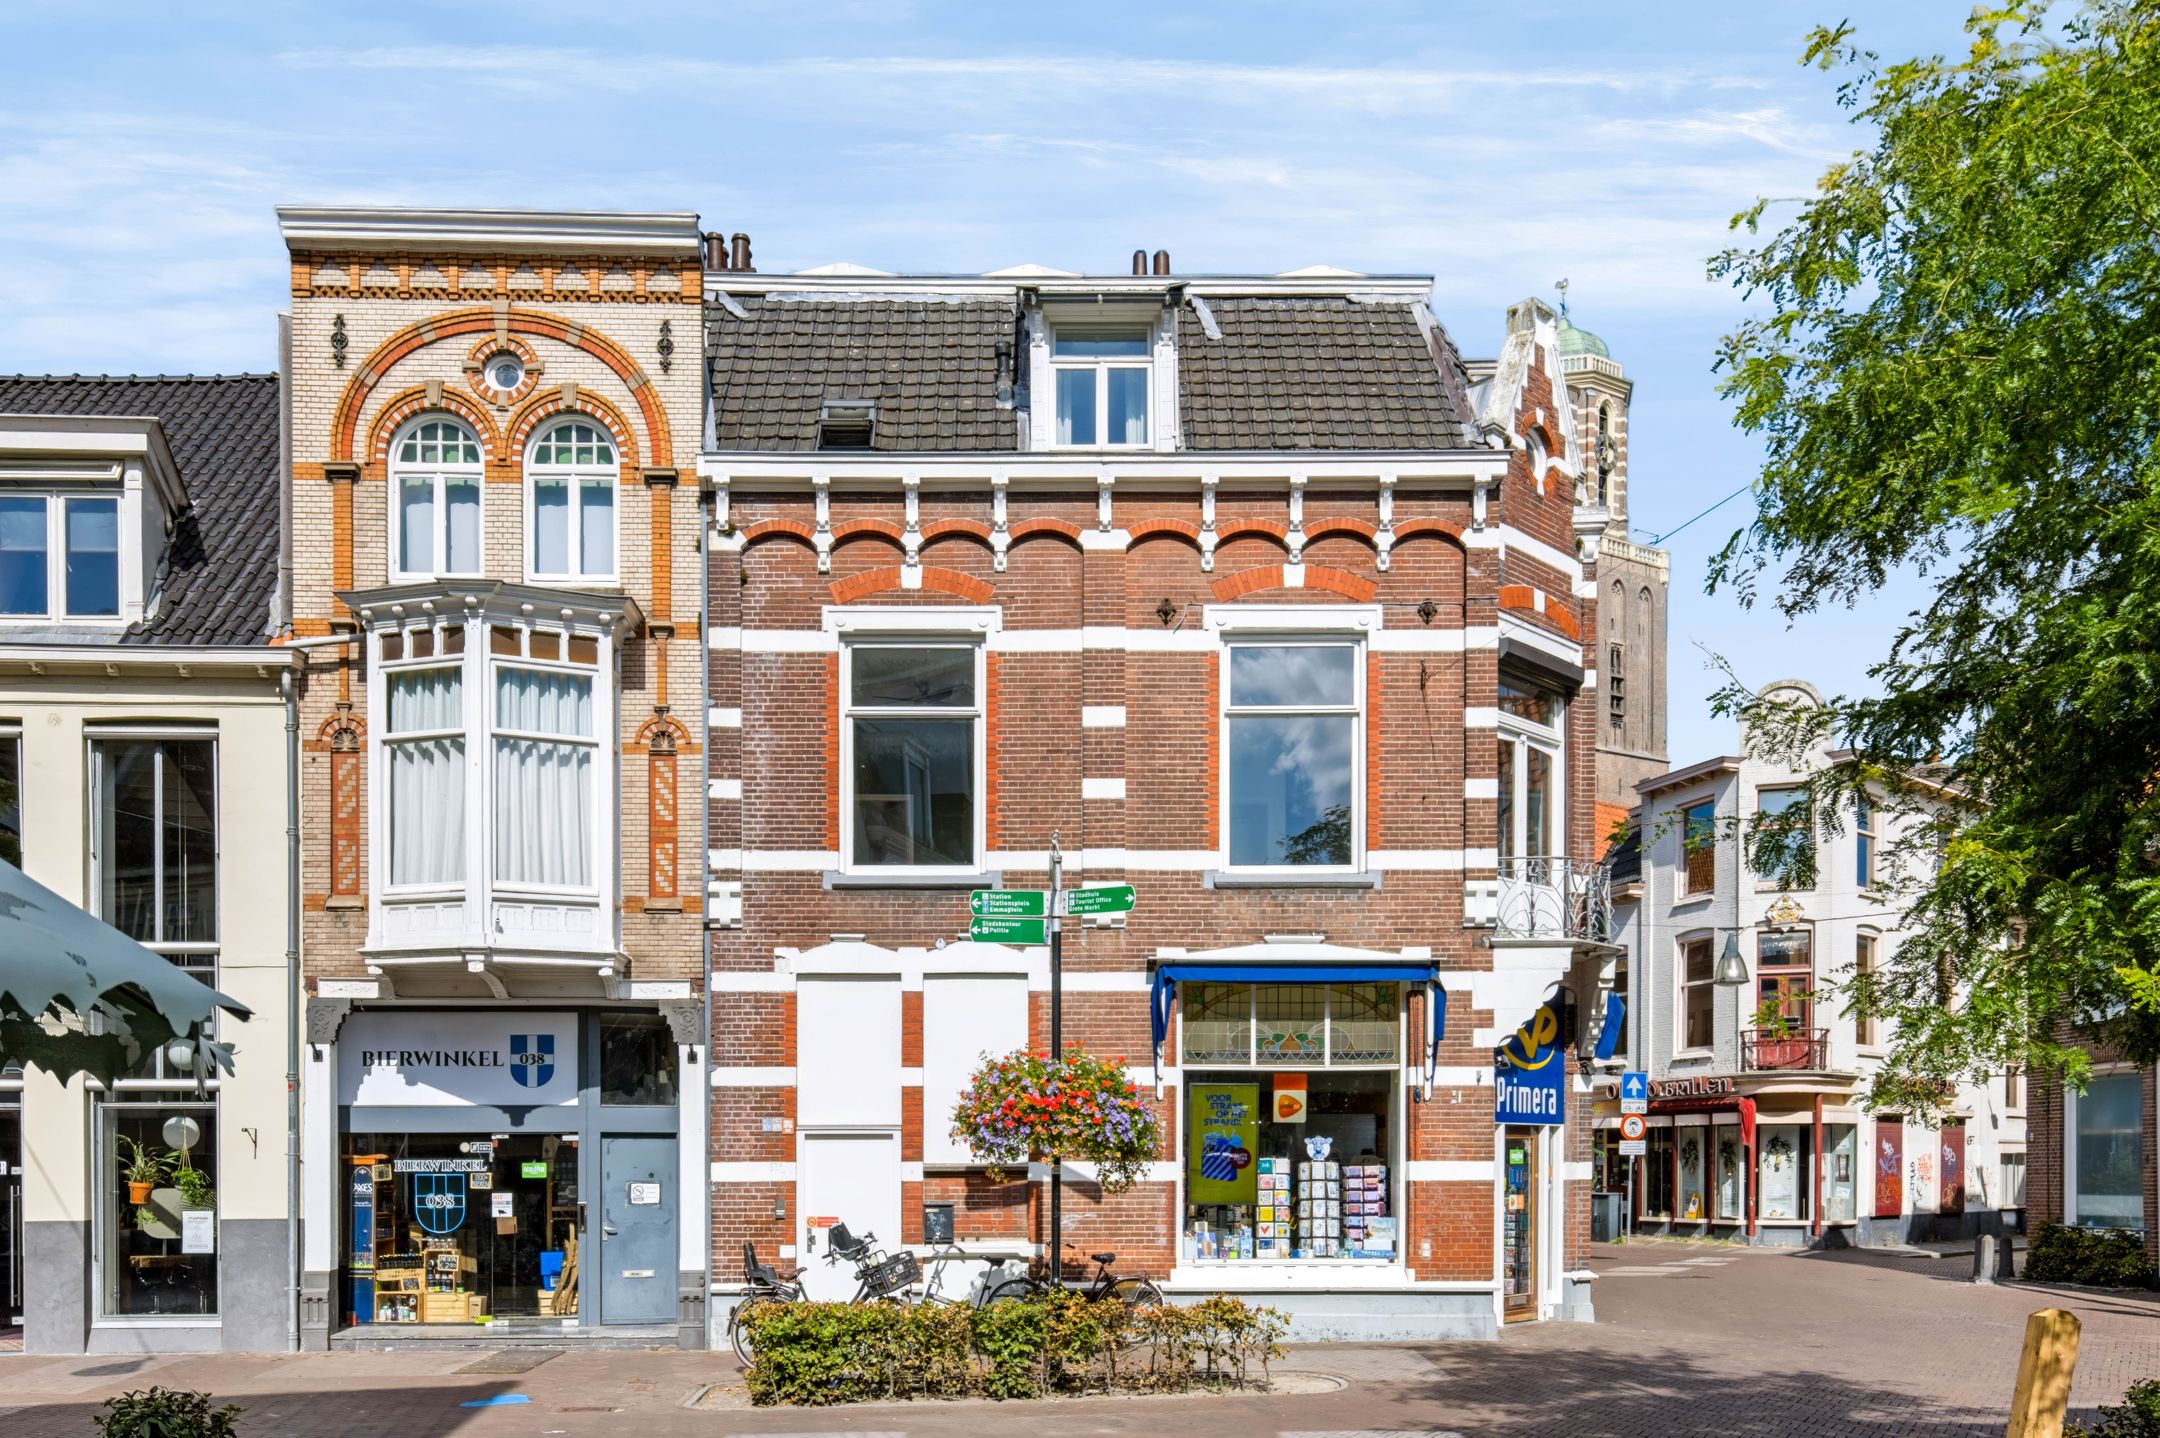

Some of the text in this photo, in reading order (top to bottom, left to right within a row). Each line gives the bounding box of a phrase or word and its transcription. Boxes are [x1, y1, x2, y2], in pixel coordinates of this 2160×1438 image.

[361, 1050, 505, 1067] BIERWINKEL
[519, 1053, 546, 1065] 038
[1205, 1094, 1232, 1102] VOOR
[1496, 1076, 1557, 1115] Primera
[1215, 1110, 1229, 1118] OP
[394, 1159, 488, 1173] BIERWINKEL
[353, 1183, 373, 1192] AXES
[425, 1193, 455, 1209] 038
